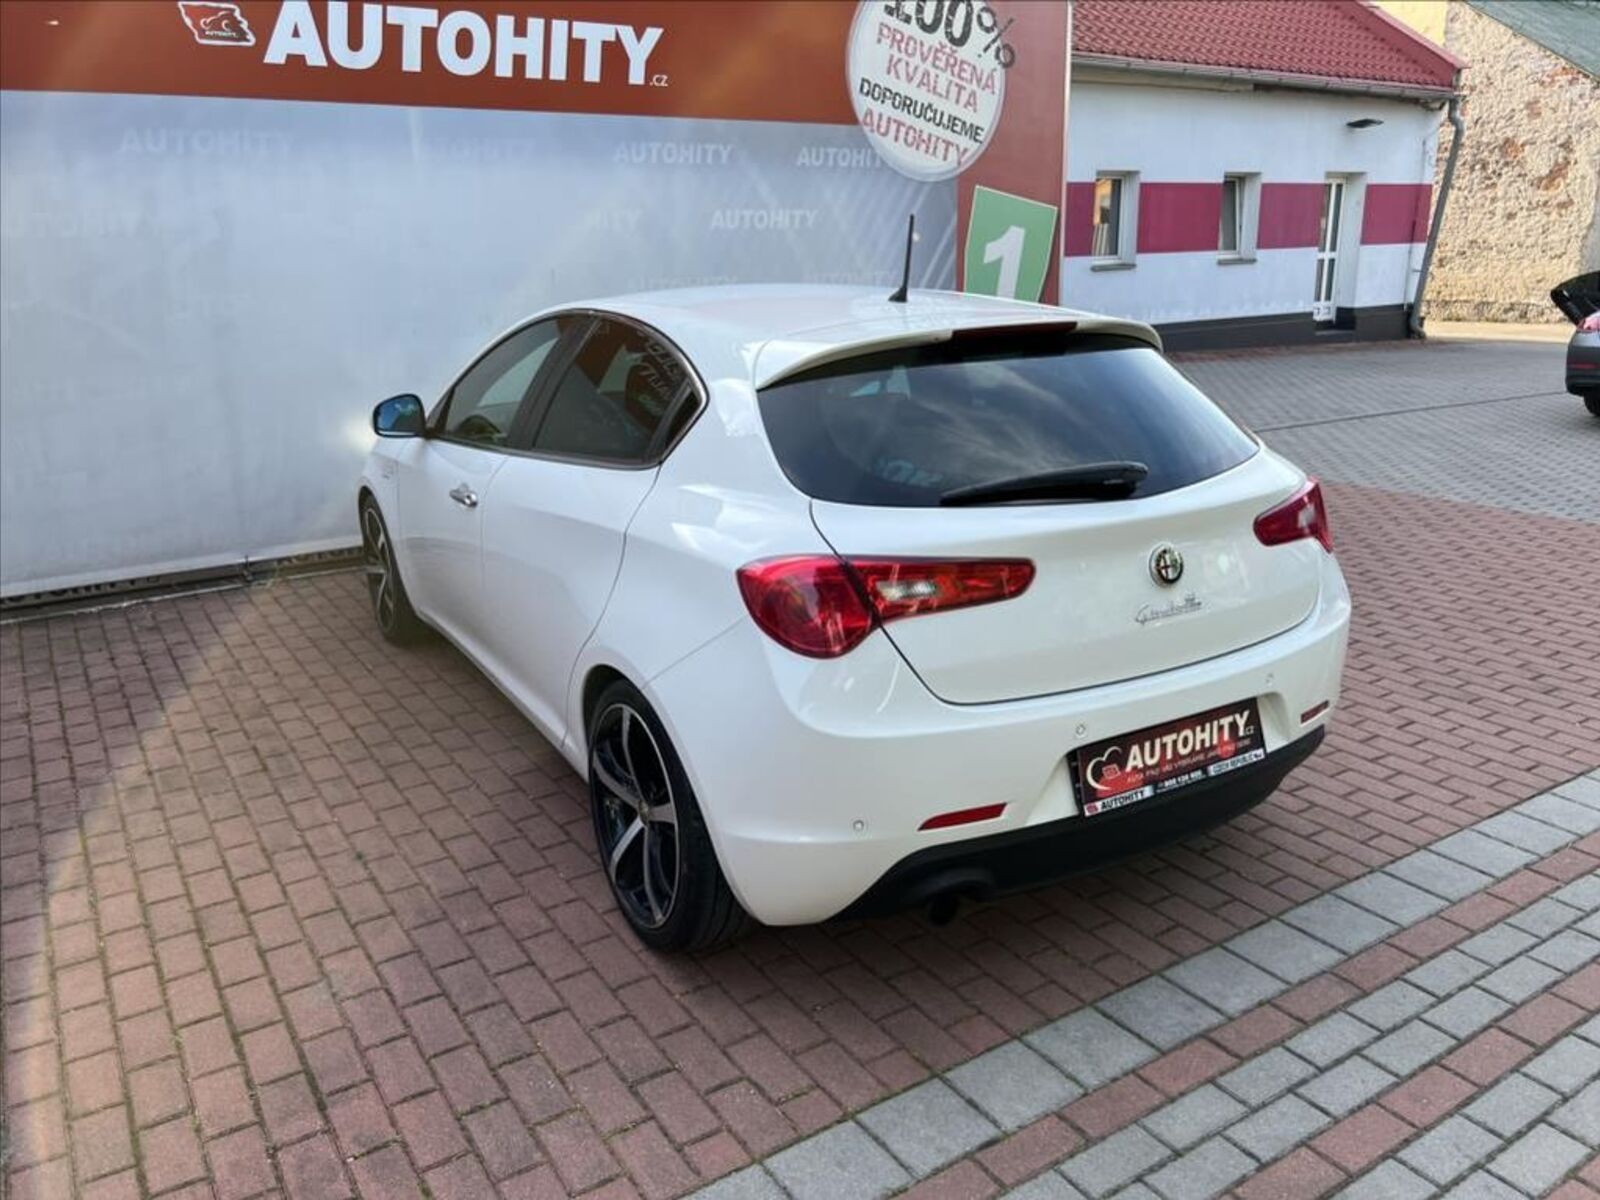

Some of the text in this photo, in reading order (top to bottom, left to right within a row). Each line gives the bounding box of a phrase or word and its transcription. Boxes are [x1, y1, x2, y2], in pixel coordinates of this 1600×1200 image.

[263, 0, 663, 85] AUTOHITY
[877, 22, 997, 95] PROVĚŘENÁ
[859, 77, 985, 144] DOPORUČUJEME
[886, 54, 978, 113] KVALITA
[613, 142, 733, 165] AUTOHITY
[862, 108, 969, 166] AUTOHITY
[710, 209, 820, 230] AUTOHITY
[1125, 711, 1250, 772] AUTOHITY
[1100, 790, 1146, 810] AUTOHITY
